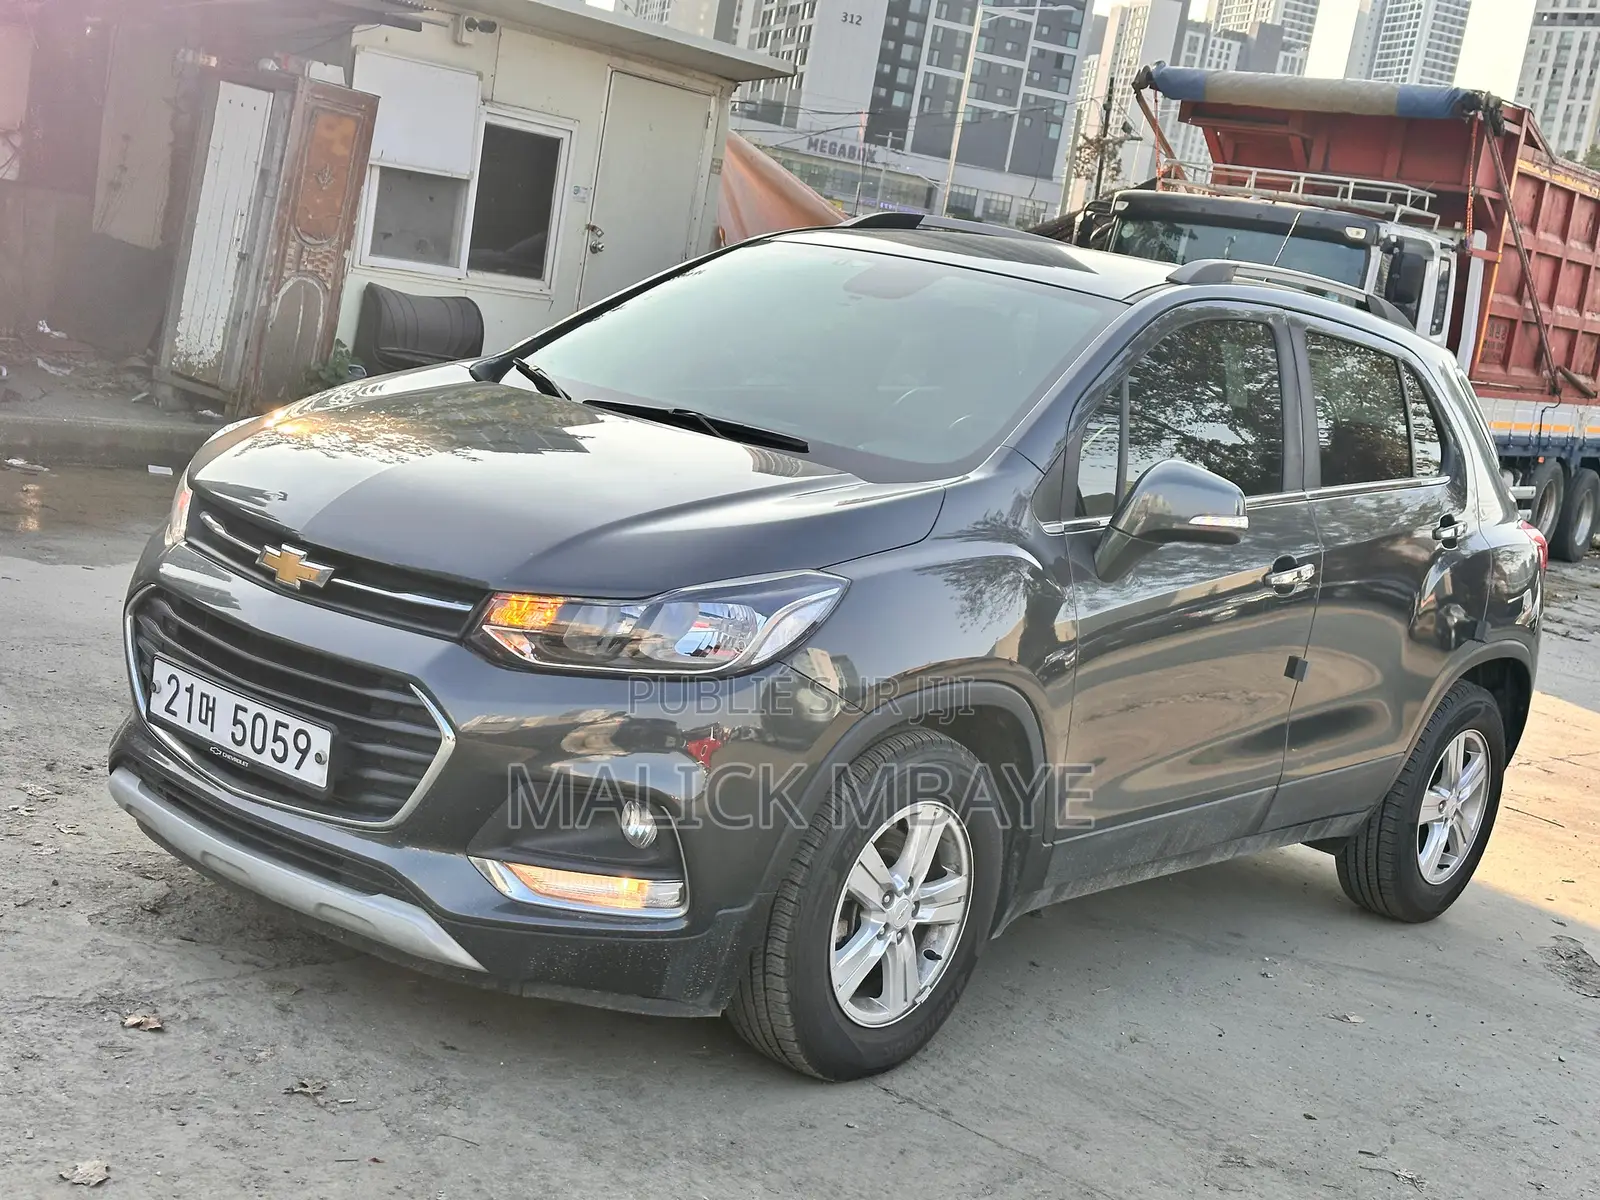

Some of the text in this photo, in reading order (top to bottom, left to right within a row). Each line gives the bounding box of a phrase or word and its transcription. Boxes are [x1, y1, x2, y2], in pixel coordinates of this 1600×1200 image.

[841, 11, 863, 26] 312
[807, 136, 876, 163] MEGABOX
[164, 673, 312, 771] 21머 5059
